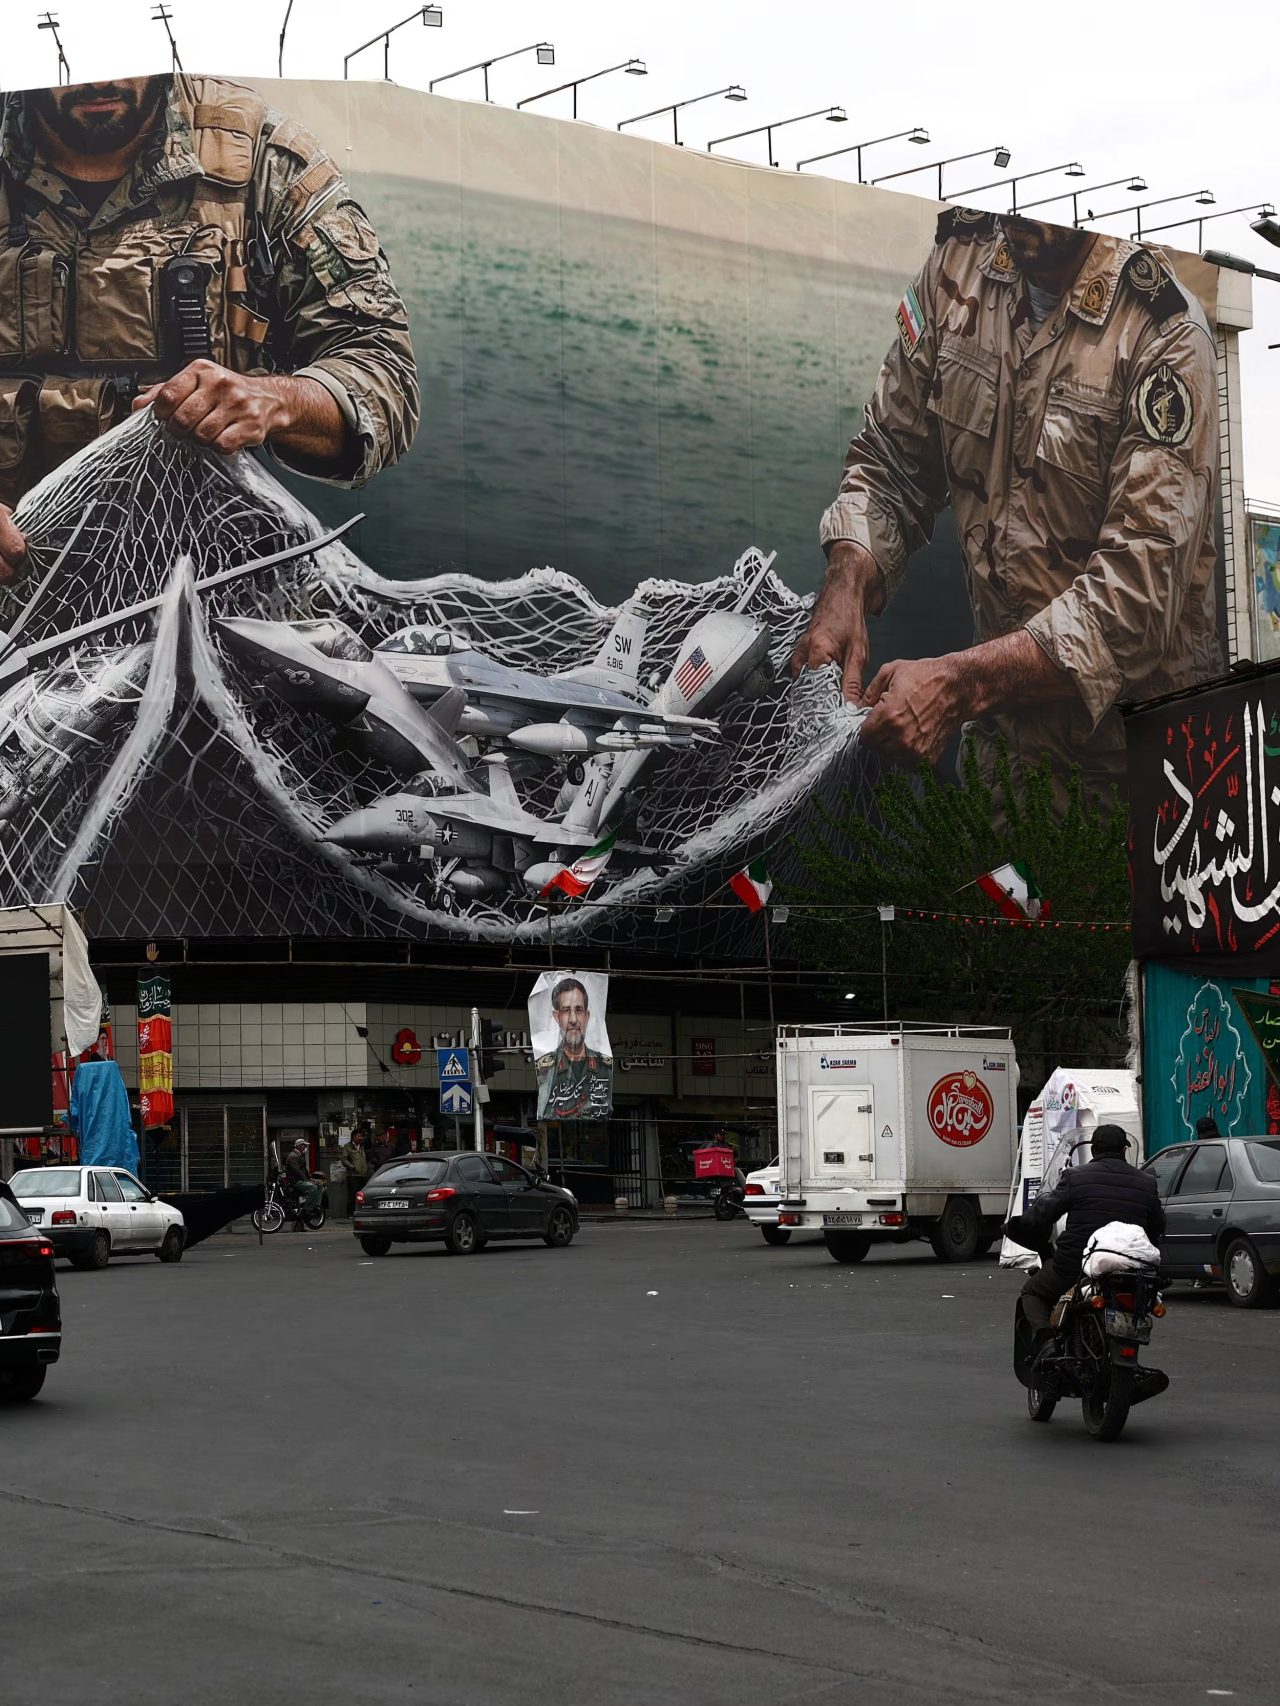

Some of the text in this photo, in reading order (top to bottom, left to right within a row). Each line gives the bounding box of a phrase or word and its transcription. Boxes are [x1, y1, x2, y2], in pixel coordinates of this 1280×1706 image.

[615, 634, 632, 655] SW
[584, 779, 599, 807] AJ
[395, 809, 414, 823] 302
